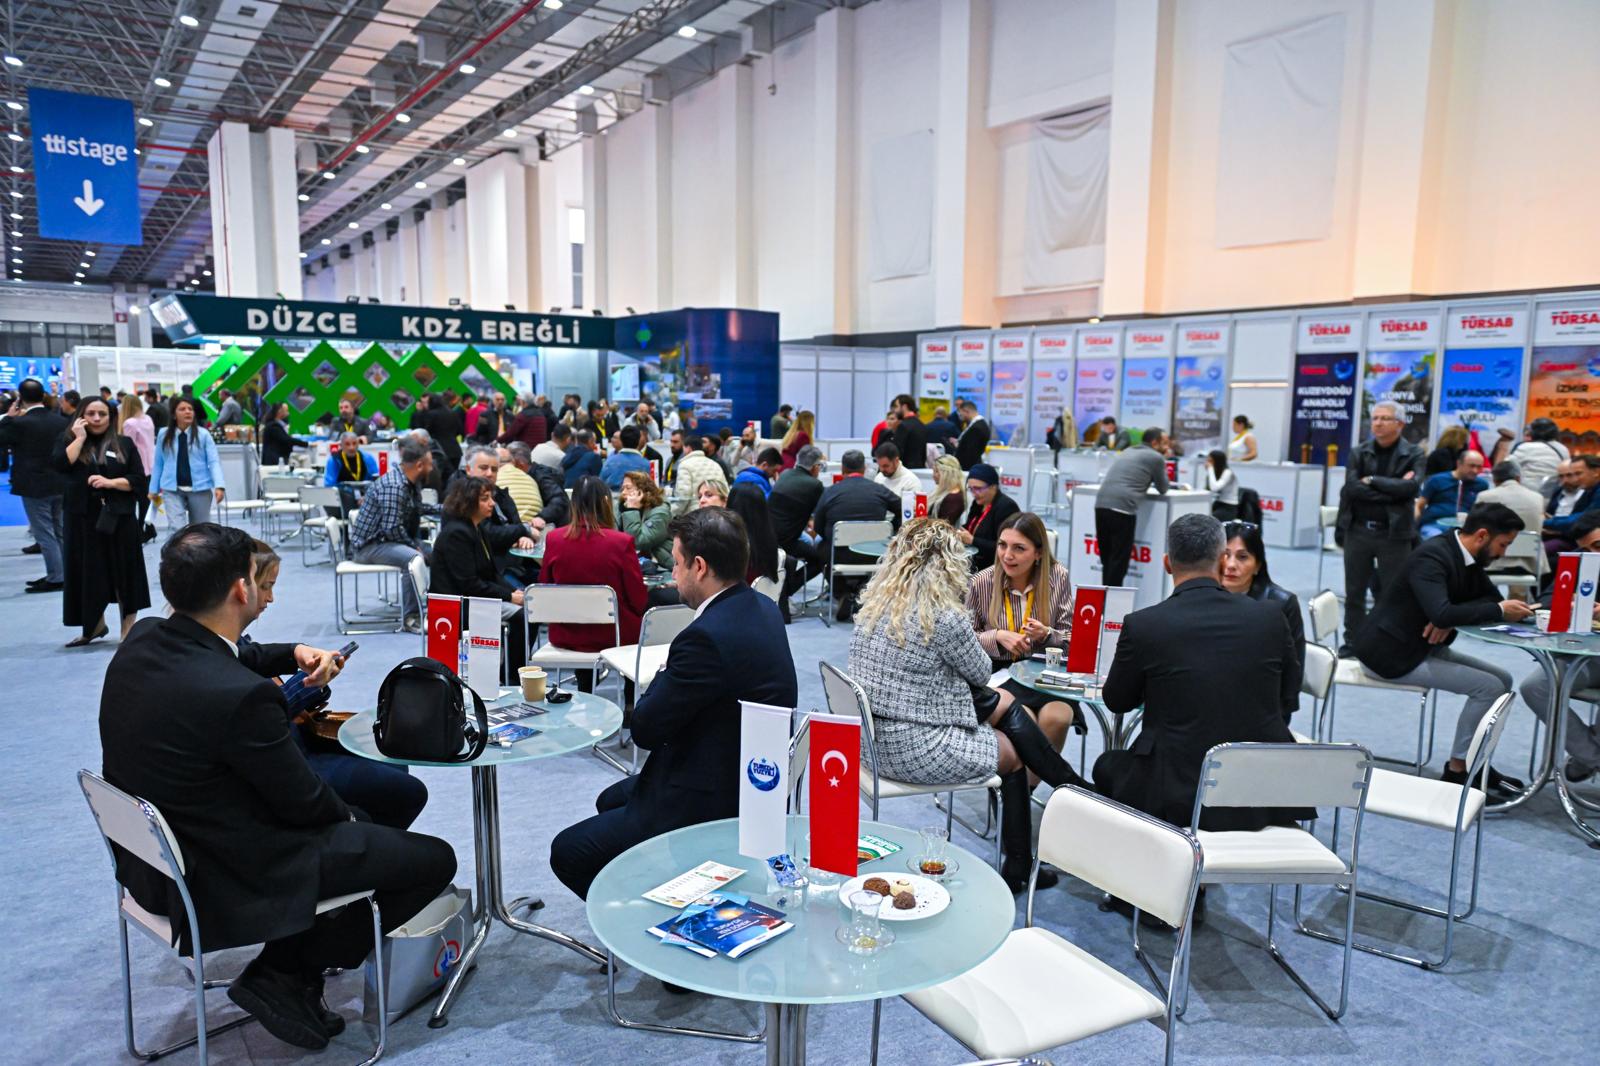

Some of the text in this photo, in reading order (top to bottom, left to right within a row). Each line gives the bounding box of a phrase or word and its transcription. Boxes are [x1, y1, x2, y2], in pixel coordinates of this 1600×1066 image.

[247, 305, 357, 335] DÜZCE
[1460, 315, 1514, 329] TÜRSAB
[1551, 311, 1600, 325] TÜRSA
[401, 316, 581, 344] KDZ. EREĞLİ
[1308, 323, 1351, 336] TÜRSAB
[1380, 319, 1428, 333] TÜRSAB
[1447, 388, 1514, 397] KAPADOKYA
[1556, 383, 1588, 393] İZMİR
[1380, 391, 1415, 401] KONYA
[1302, 398, 1346, 408] ANADOLU
[470, 636, 499, 647] TÜRSAB
